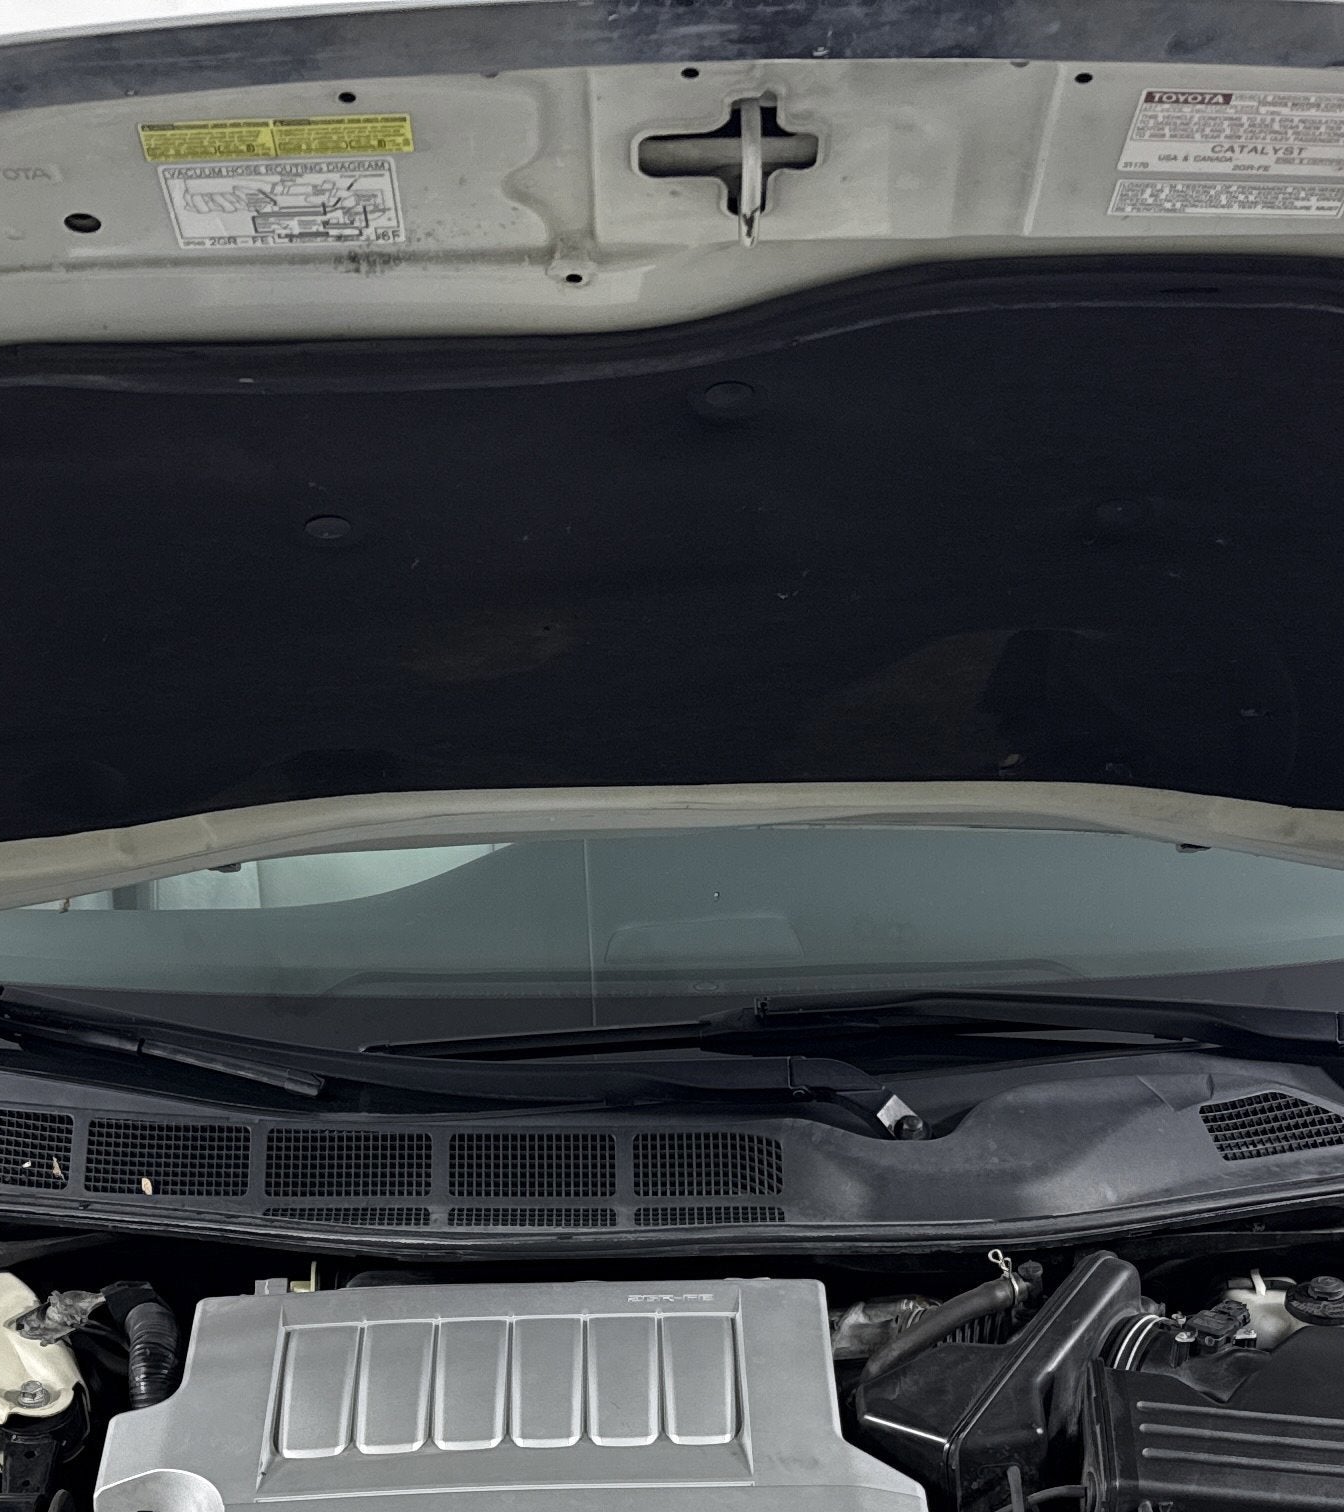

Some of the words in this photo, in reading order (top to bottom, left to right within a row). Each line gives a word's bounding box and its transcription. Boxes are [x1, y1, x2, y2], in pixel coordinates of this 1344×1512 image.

[1151, 92, 1225, 104] TOYOTA
[1210, 144, 1309, 156] CATALYST
[1158, 154, 1179, 162] USA
[1193, 155, 1233, 163] CANADA
[168, 168, 224, 179] VACUUM
[226, 166, 261, 177] HOSE
[265, 163, 323, 176] ROUTING
[327, 161, 386, 172] DIAGRAM
